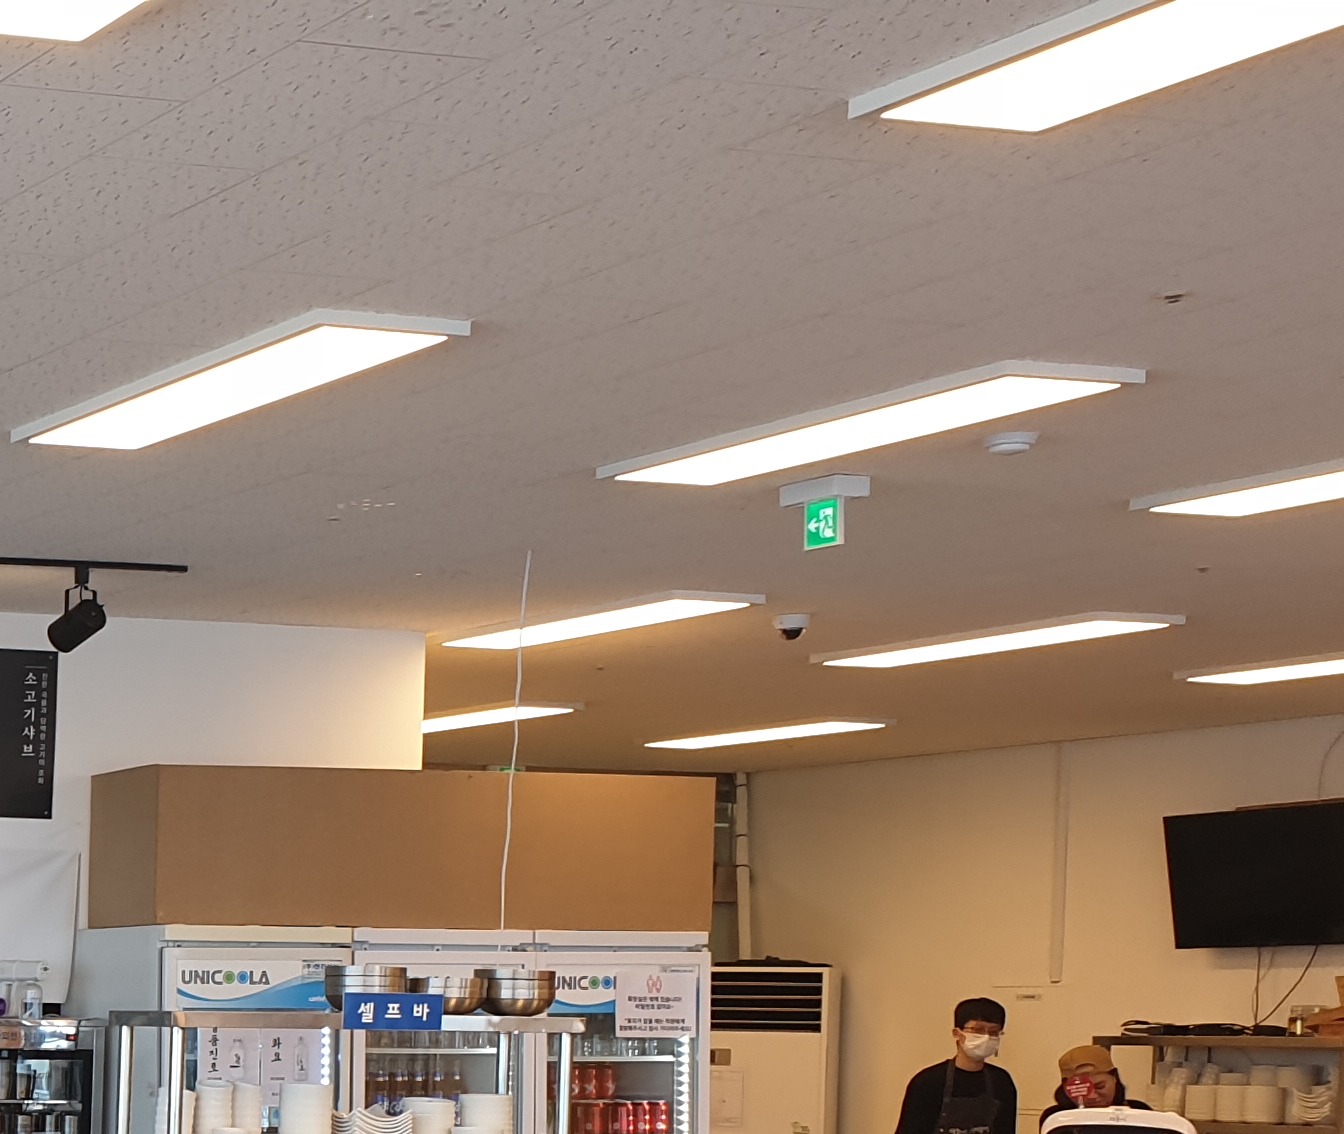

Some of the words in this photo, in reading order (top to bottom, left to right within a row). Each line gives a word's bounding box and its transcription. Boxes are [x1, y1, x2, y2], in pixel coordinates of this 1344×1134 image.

[22, 672, 37, 757] 소고기샤브
[181, 969, 271, 986] UNICOOLA
[357, 1001, 431, 1023] 셀프바
